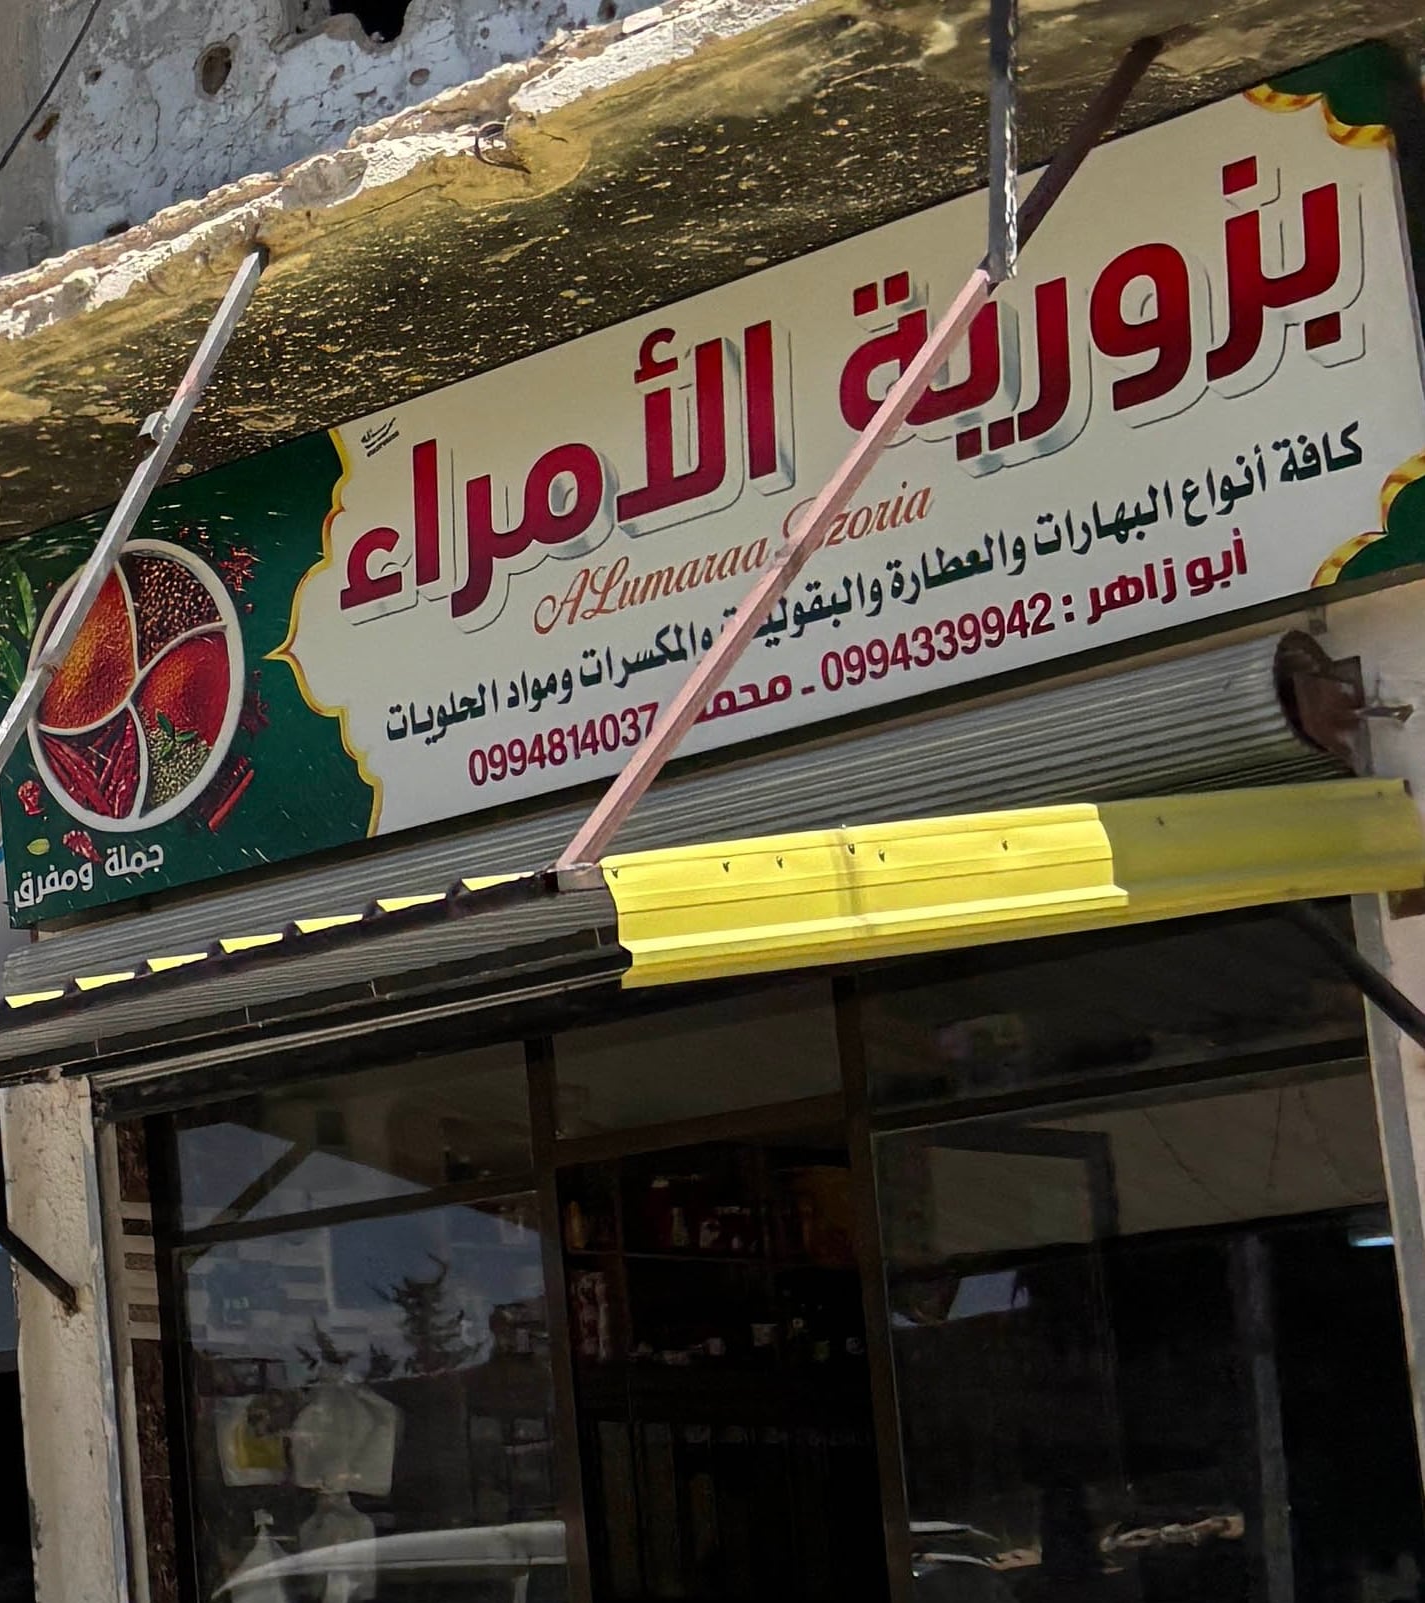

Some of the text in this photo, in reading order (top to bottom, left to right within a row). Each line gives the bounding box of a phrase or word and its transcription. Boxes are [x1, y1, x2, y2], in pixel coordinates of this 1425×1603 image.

[340, 155, 1342, 620] بزورية الأمراء
[1184, 445, 1267, 526] أنواع
[1280, 421, 1363, 482] كافة
[783, 481, 932, 561] zoria
[1034, 480, 1174, 557] البهارات
[886, 528, 1027, 602] والعطارة
[467, 528, 1249, 787] أبو زاهر 0994339942 محم 0994814037
[507, 667, 574, 713] ومواد
[385, 678, 499, 745] الحلويات
[13, 844, 164, 912] جملة ومفرق
